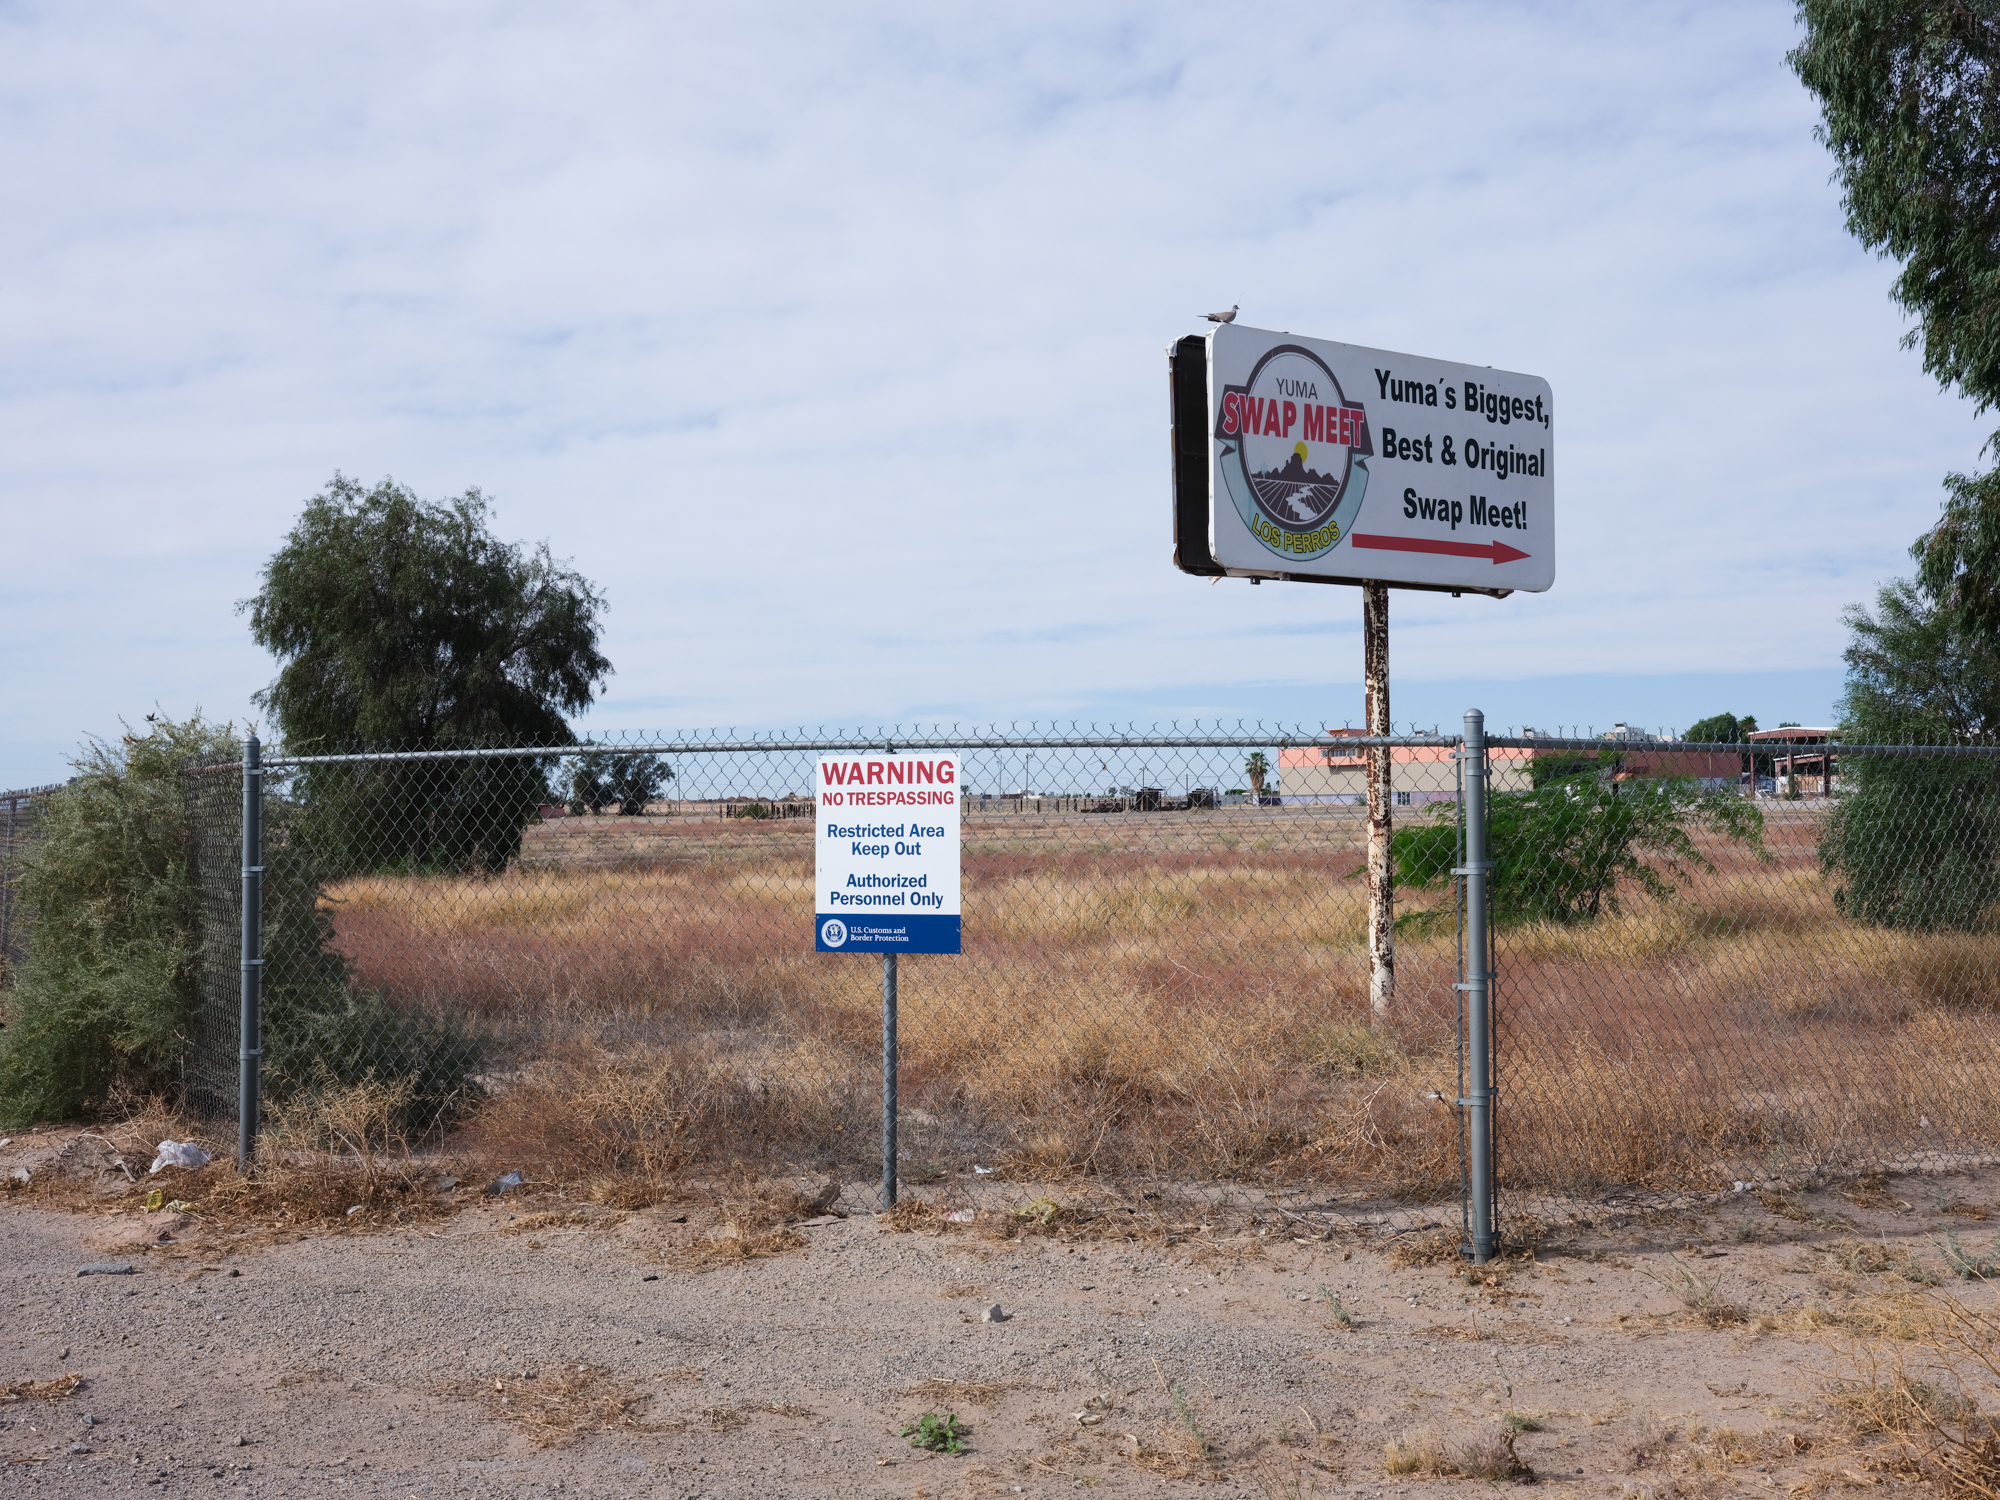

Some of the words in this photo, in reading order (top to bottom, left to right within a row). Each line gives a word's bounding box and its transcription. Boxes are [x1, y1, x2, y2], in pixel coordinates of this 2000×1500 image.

[1276, 377, 1318, 400] YUMA
[1464, 381, 1549, 430] Biggest,
[1223, 391, 1297, 438] SWAP
[1303, 403, 1364, 447] MEET
[1382, 428, 1433, 464] Best
[1440, 435, 1456, 466] &
[1464, 440, 1545, 480] Original
[1403, 488, 1463, 530] Swap
[1470, 495, 1527, 530] Meet!
[1252, 513, 1280, 547] LOS
[1284, 521, 1340, 553] PERROS
[822, 760, 954, 785] WARNING
[822, 792, 844, 806] NO
[847, 791, 954, 806] TRESPASSING
[827, 823, 905, 838] Restricted
[909, 823, 945, 838] Area
[851, 841, 890, 859] Keep
[894, 841, 922, 856] Out
[846, 873, 927, 888] Authorized
[830, 891, 905, 906] Personnel
[910, 891, 943, 909] Only
[850, 926, 863, 934] U.S.
[863, 926, 892, 934] Customs
[893, 926, 906, 934] and
[850, 934, 873, 942] Border
[874, 934, 909, 942] Protection
